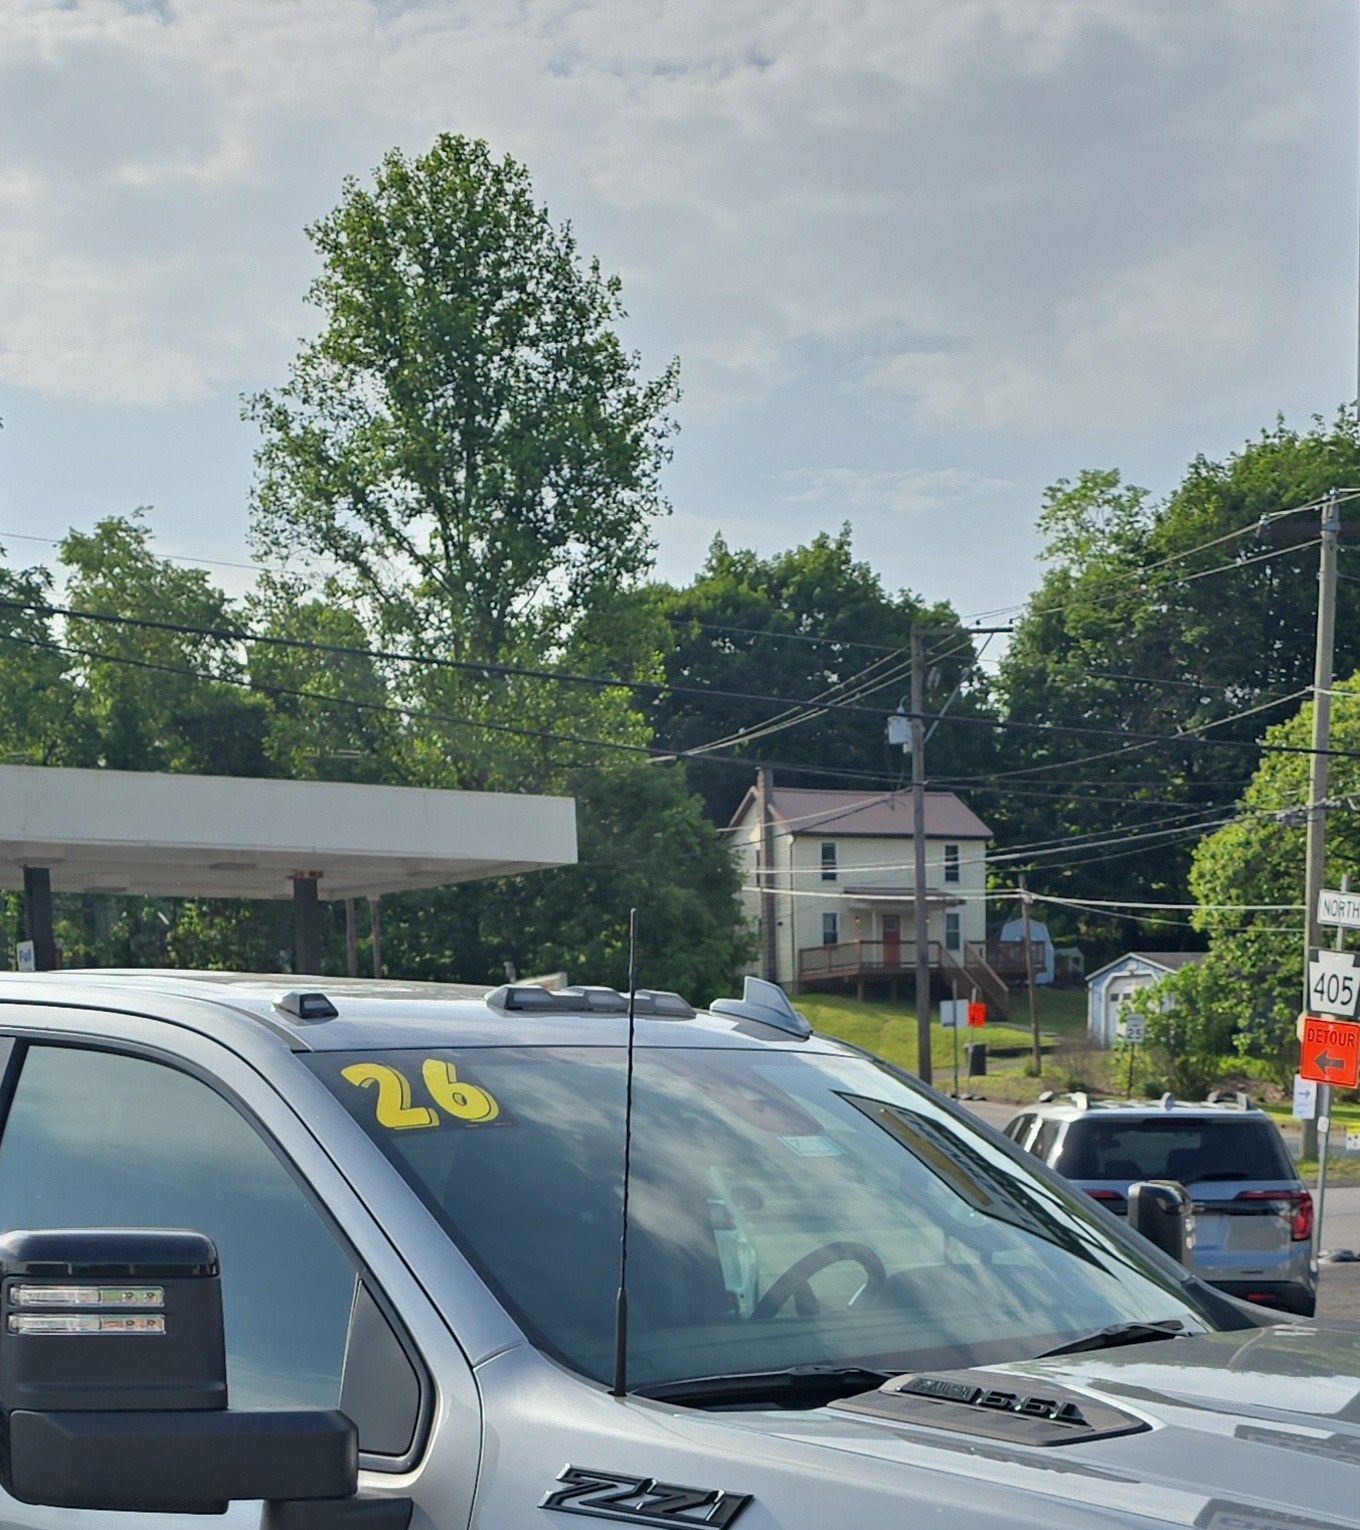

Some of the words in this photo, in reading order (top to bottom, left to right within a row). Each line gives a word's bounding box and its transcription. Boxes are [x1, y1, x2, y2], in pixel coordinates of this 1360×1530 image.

[1323, 899, 1360, 918] NORTH
[1313, 973, 1353, 1006] 405
[1307, 1028, 1355, 1048] DETOUR
[341, 1059, 499, 1130] 26
